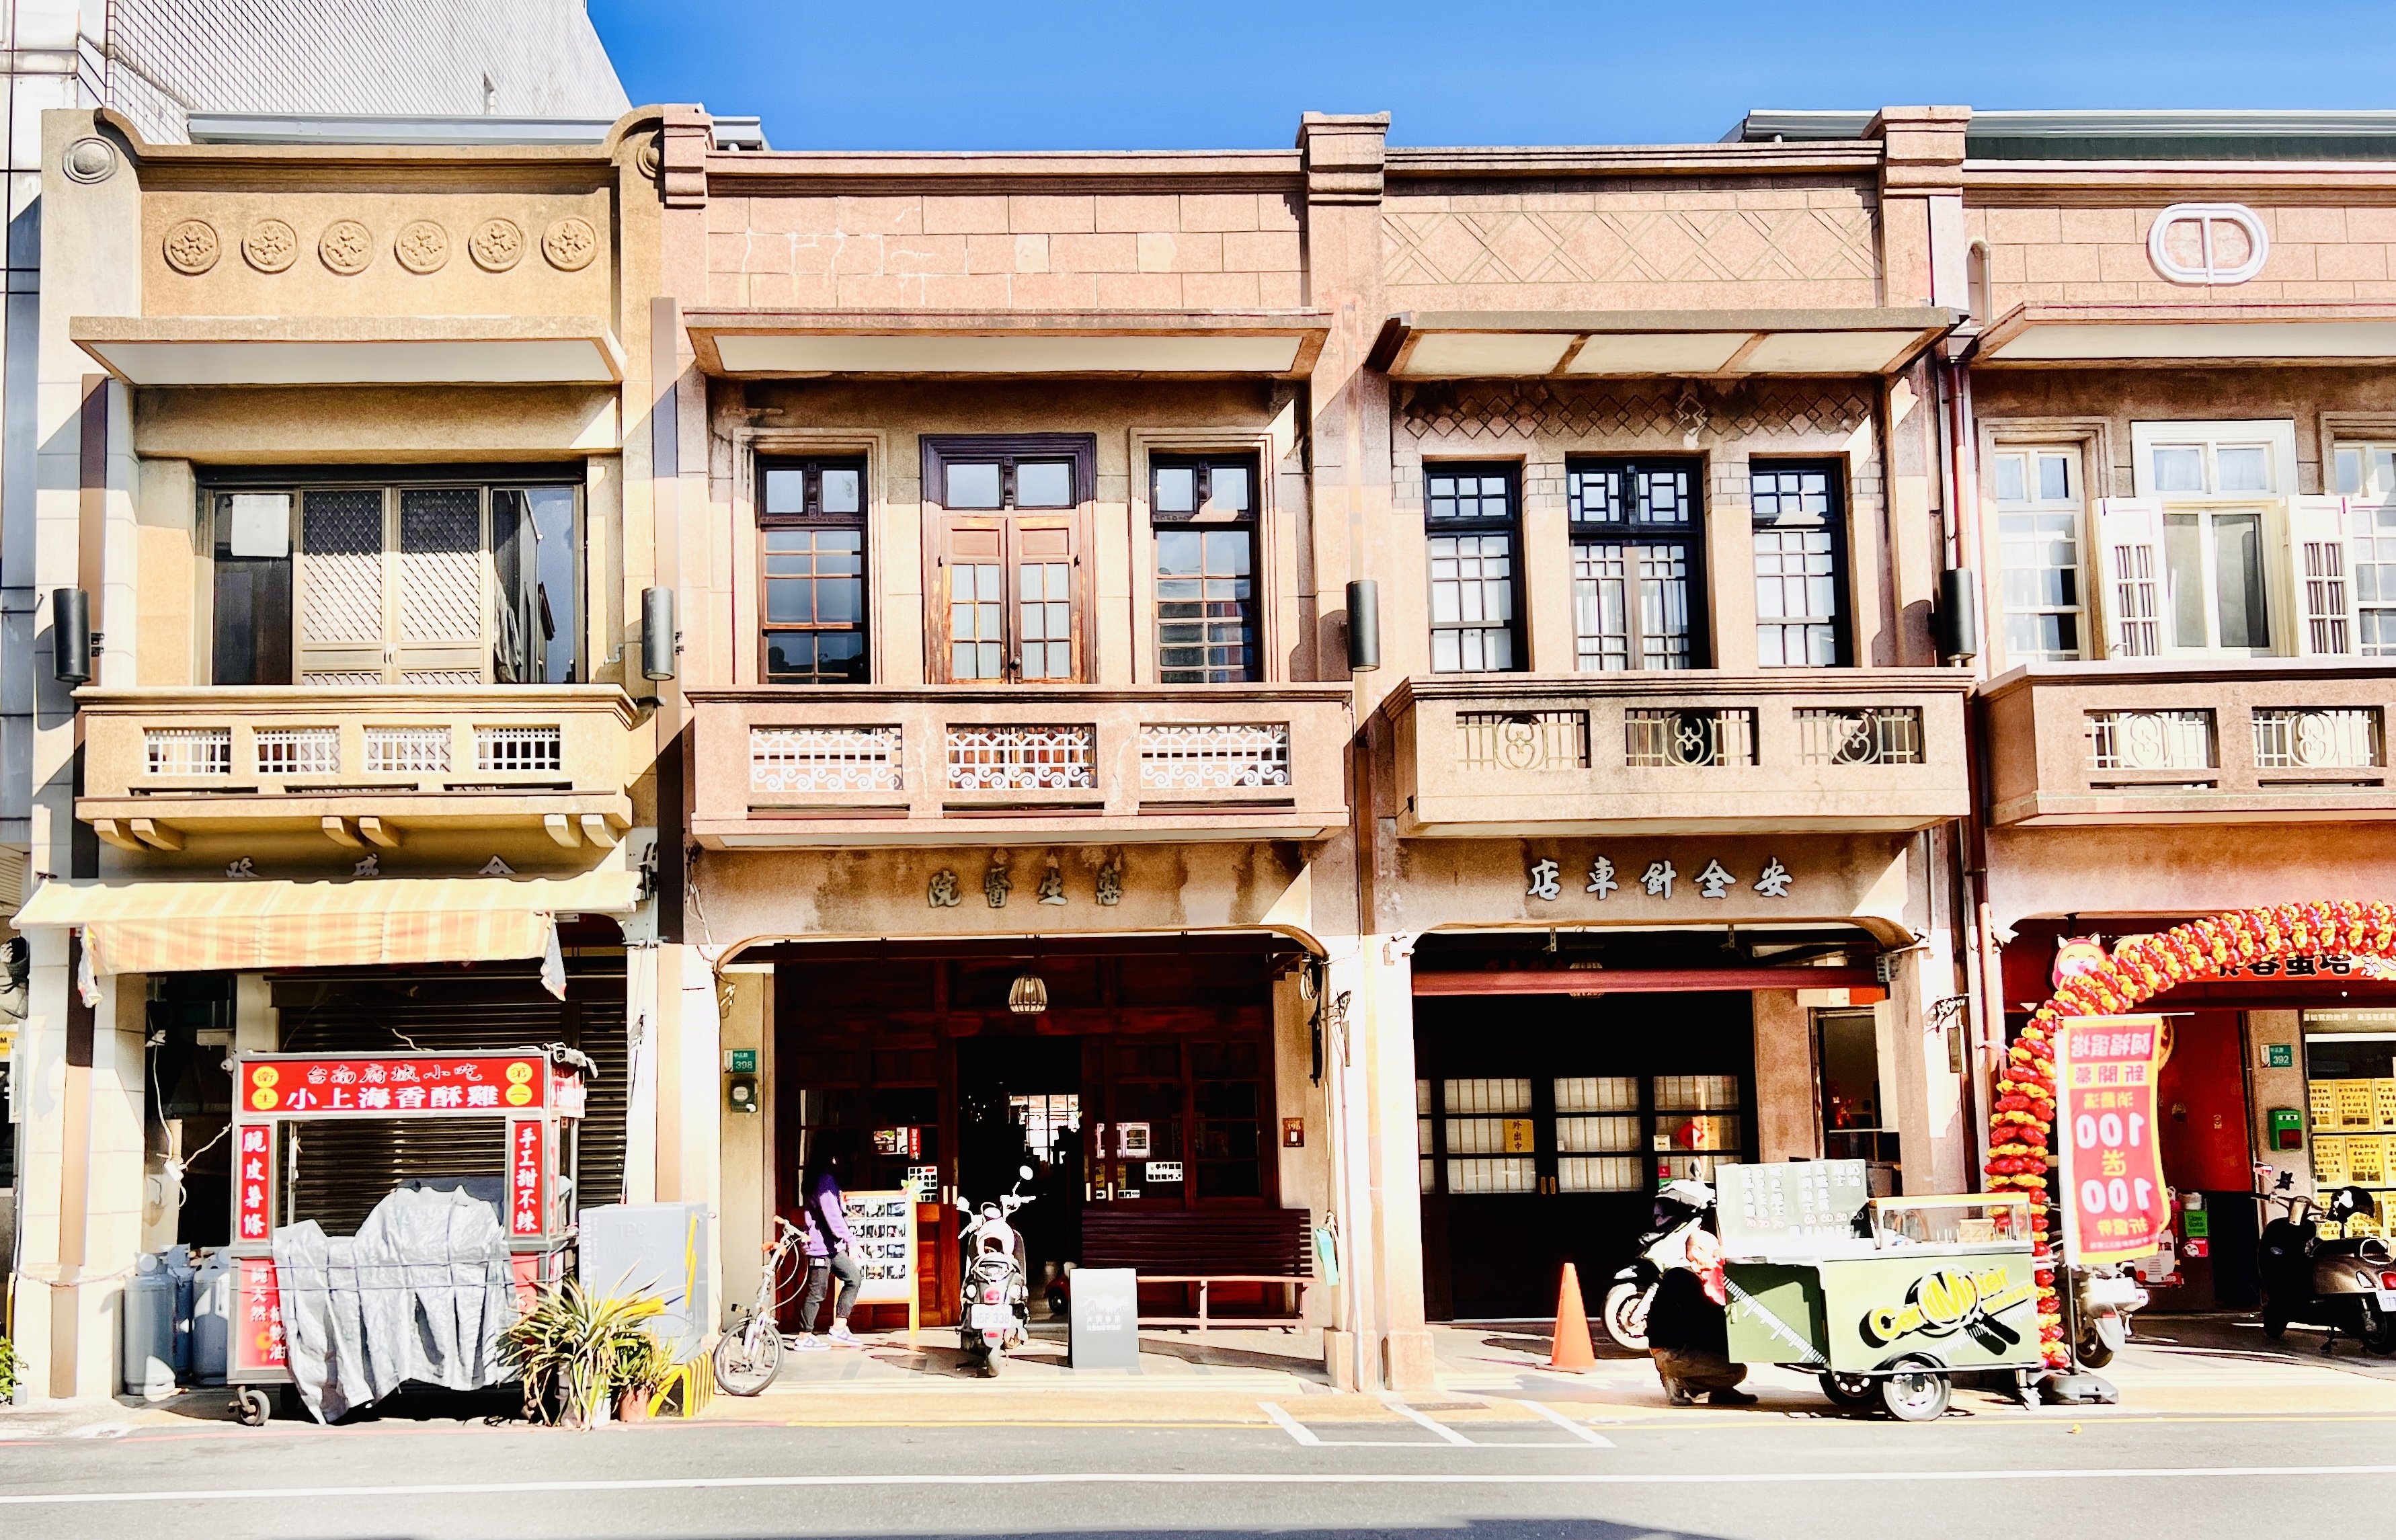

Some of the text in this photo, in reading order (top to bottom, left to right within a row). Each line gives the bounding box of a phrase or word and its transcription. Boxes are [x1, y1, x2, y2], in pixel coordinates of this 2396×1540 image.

[735, 1061, 754, 1069] 398
[2273, 1055, 2289, 1064] 392
[307, 1063, 483, 1085] 台南府城小吃
[286, 1086, 500, 1109] 小上海香酥雞
[243, 1130, 267, 1236] 脆皮薯條
[514, 1127, 538, 1233] 手工甜不辣
[250, 1266, 268, 1323] 純天然
